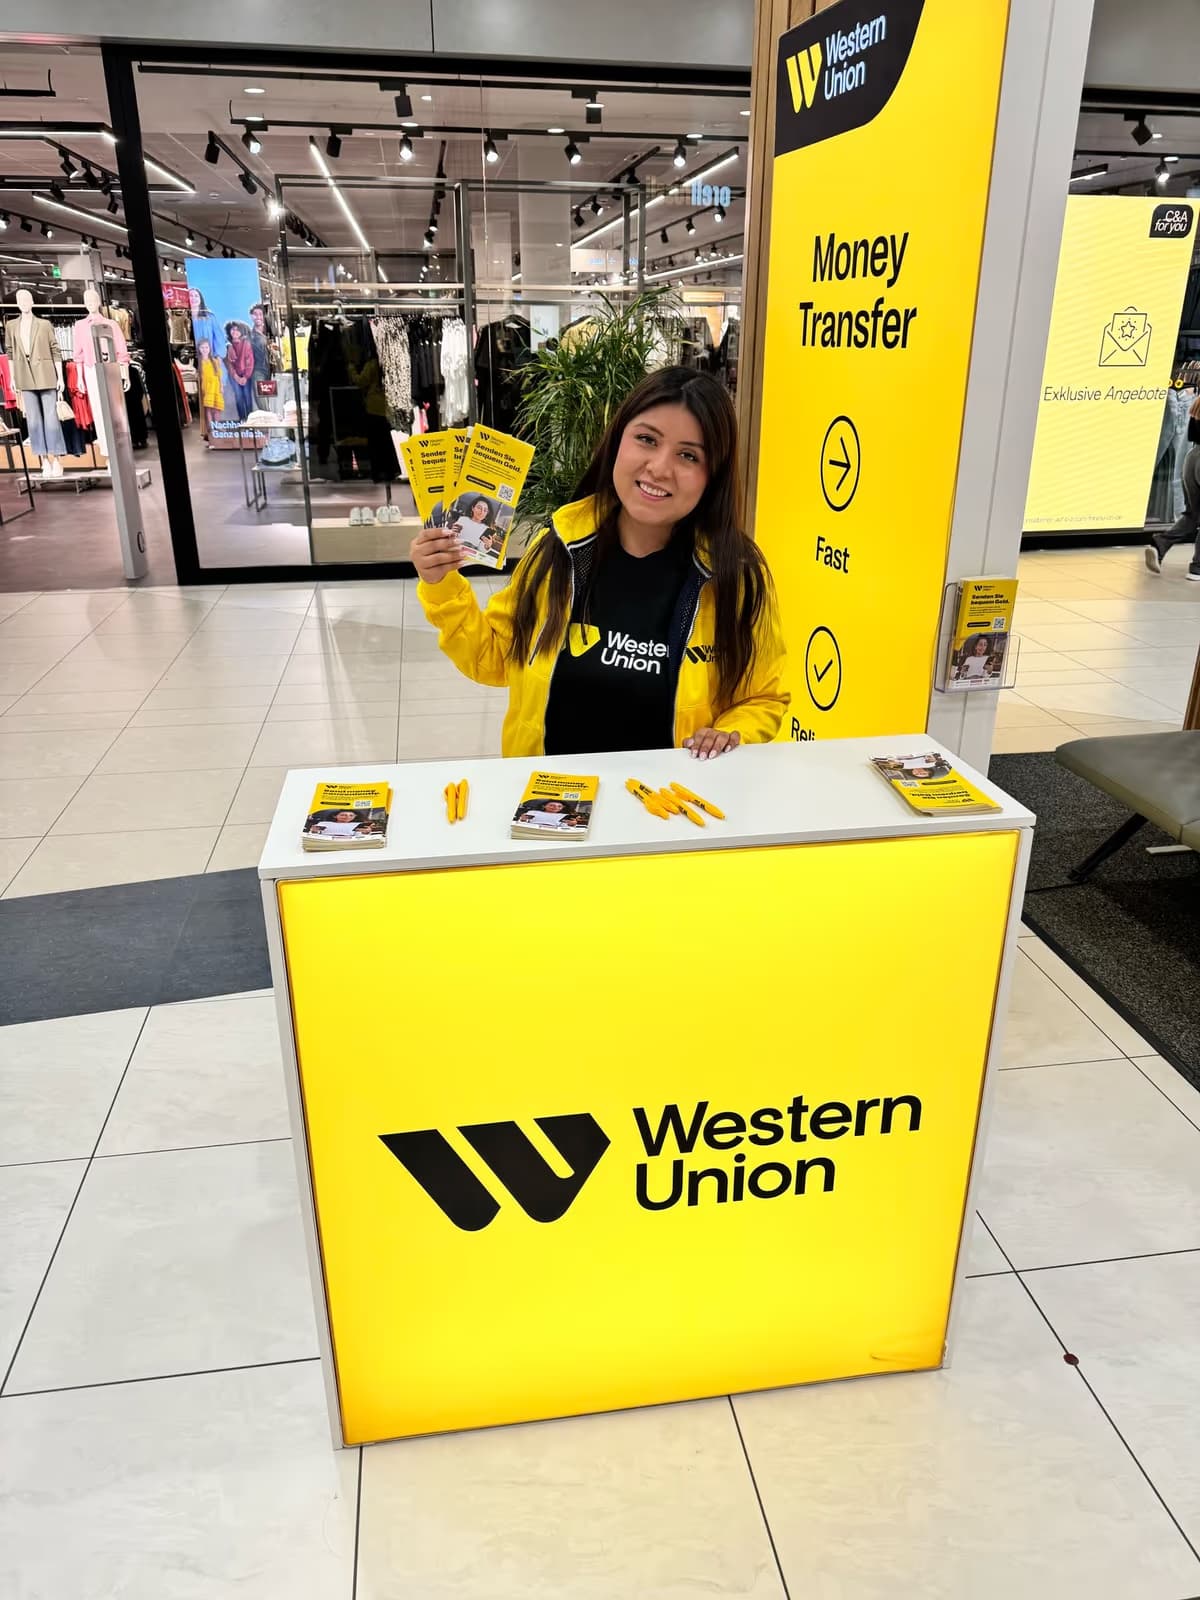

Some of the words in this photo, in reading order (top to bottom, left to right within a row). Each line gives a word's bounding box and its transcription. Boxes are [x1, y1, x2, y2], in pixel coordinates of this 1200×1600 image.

[825, 15, 886, 67] Western
[824, 60, 865, 100] Union
[1154, 218, 1168, 231] for
[1167, 222, 1187, 234] you
[1163, 210, 1188, 222] C&A
[812, 232, 909, 289] Money
[799, 296, 917, 350] Transfer
[1043, 386, 1102, 402] Exklusive
[1104, 385, 1167, 404] Angebote
[473, 448, 503, 465] bequem
[475, 442, 503, 458] Senden
[503, 453, 515, 463] Sie
[816, 535, 850, 574] Fast
[600, 648, 661, 674] Union
[633, 1095, 922, 1157] Western
[636, 1153, 836, 1211] Union
